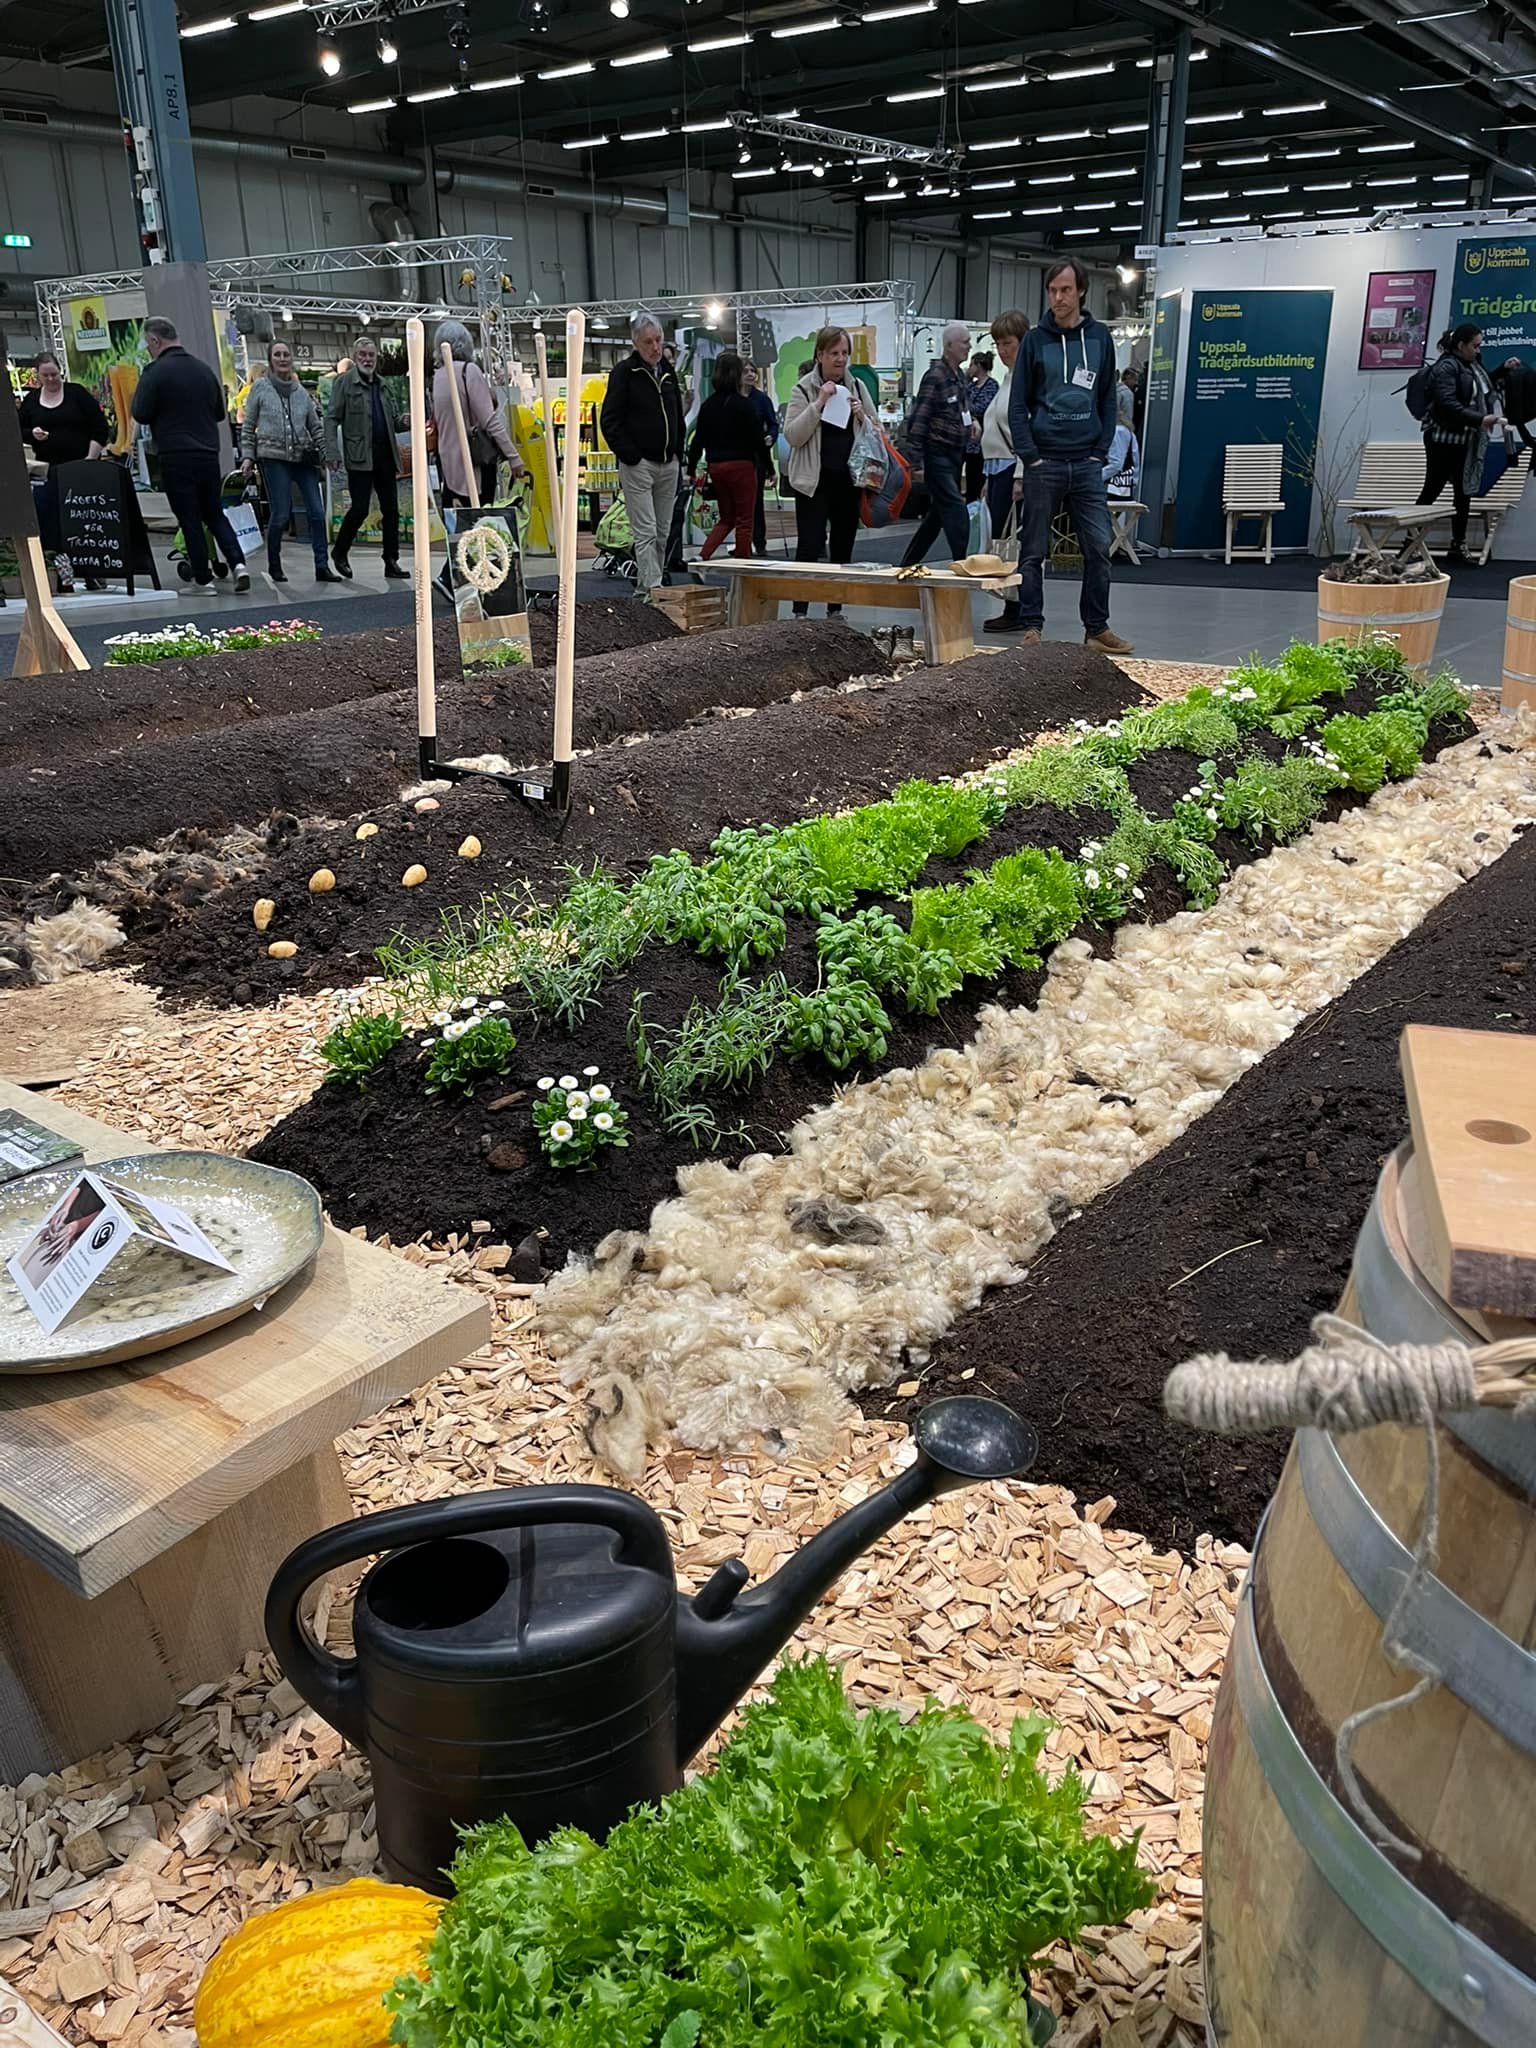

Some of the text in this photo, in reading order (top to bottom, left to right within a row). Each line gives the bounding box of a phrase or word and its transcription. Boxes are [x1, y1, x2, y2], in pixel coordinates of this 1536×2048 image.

[1487, 246, 1527, 259] Uppsala
[1486, 258, 1530, 268] kommun
[1498, 326, 1523, 337] jobbet
[297, 345, 310, 357] 23
[1200, 340, 1247, 356] Uppsala
[1198, 353, 1315, 371] Trädgårdsutbildning
